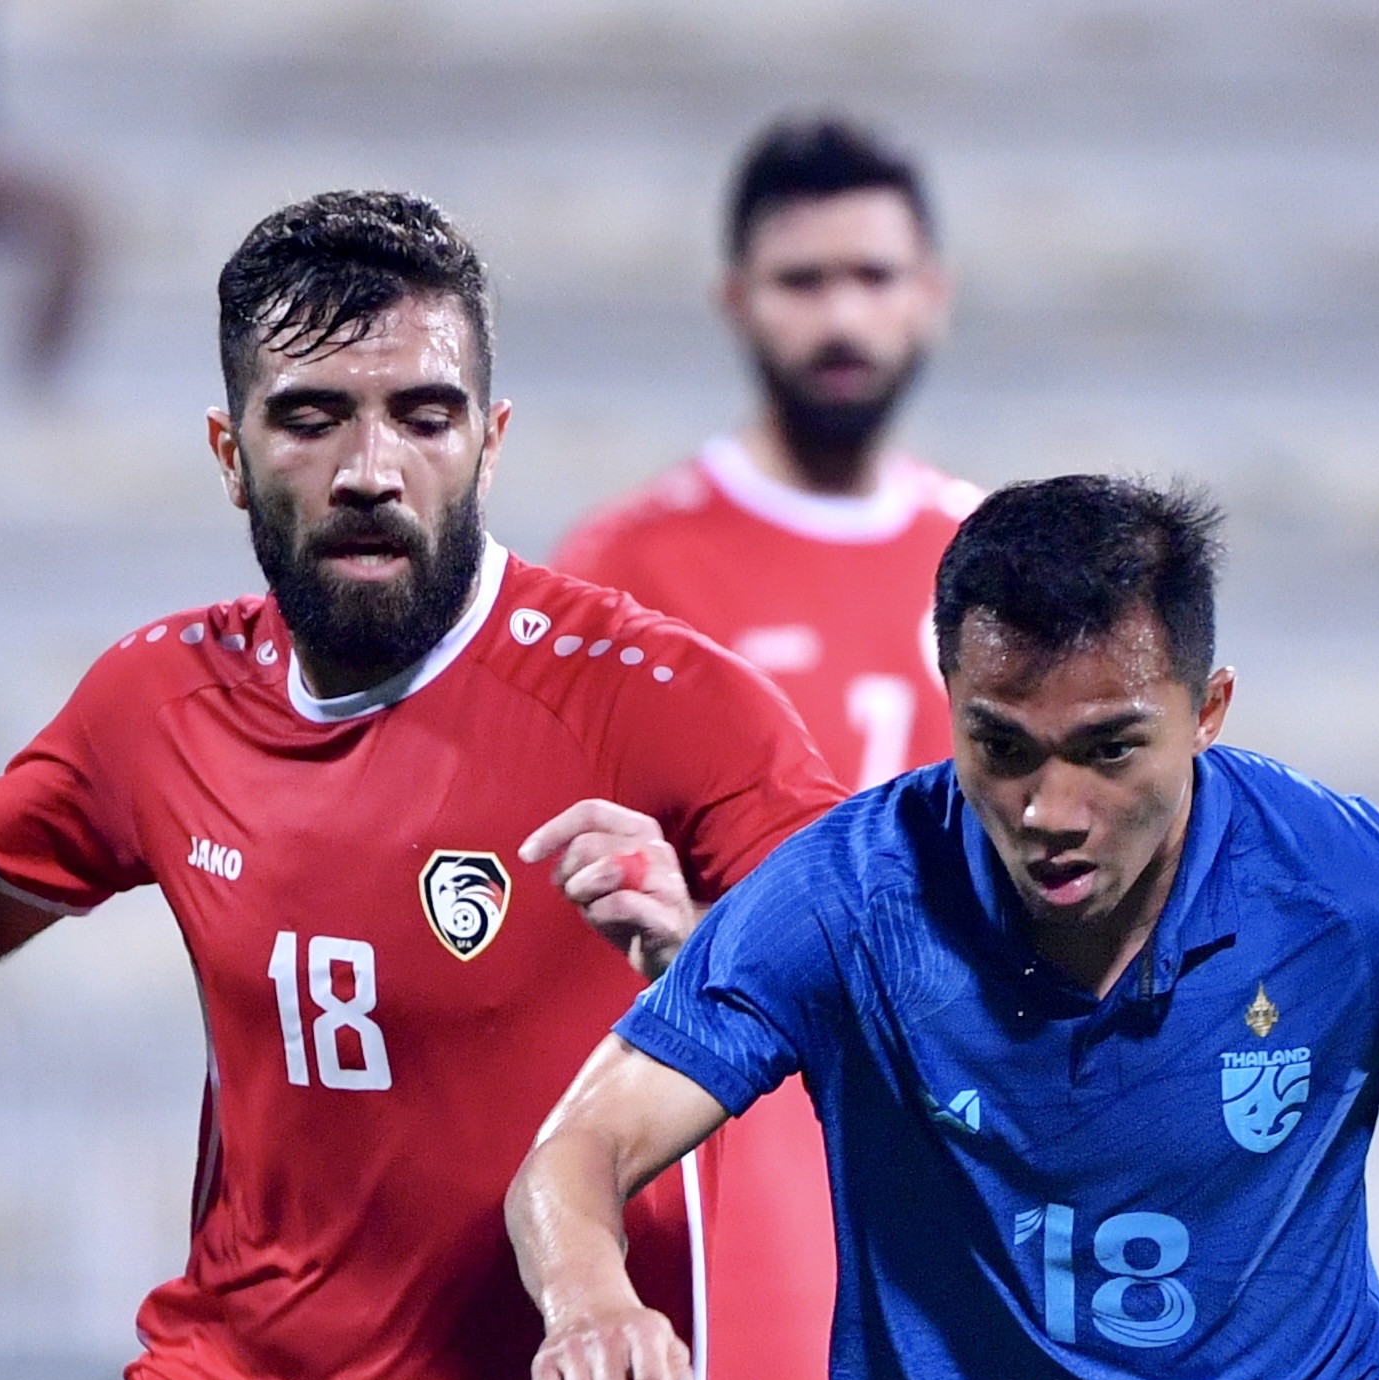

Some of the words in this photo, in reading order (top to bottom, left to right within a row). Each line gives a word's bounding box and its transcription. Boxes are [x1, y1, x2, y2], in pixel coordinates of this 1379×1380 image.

[187, 835, 242, 881] JAKO
[268, 931, 392, 1091] 18
[1220, 1047, 1310, 1068] THAILAND
[1014, 1203, 1196, 1348] 18
